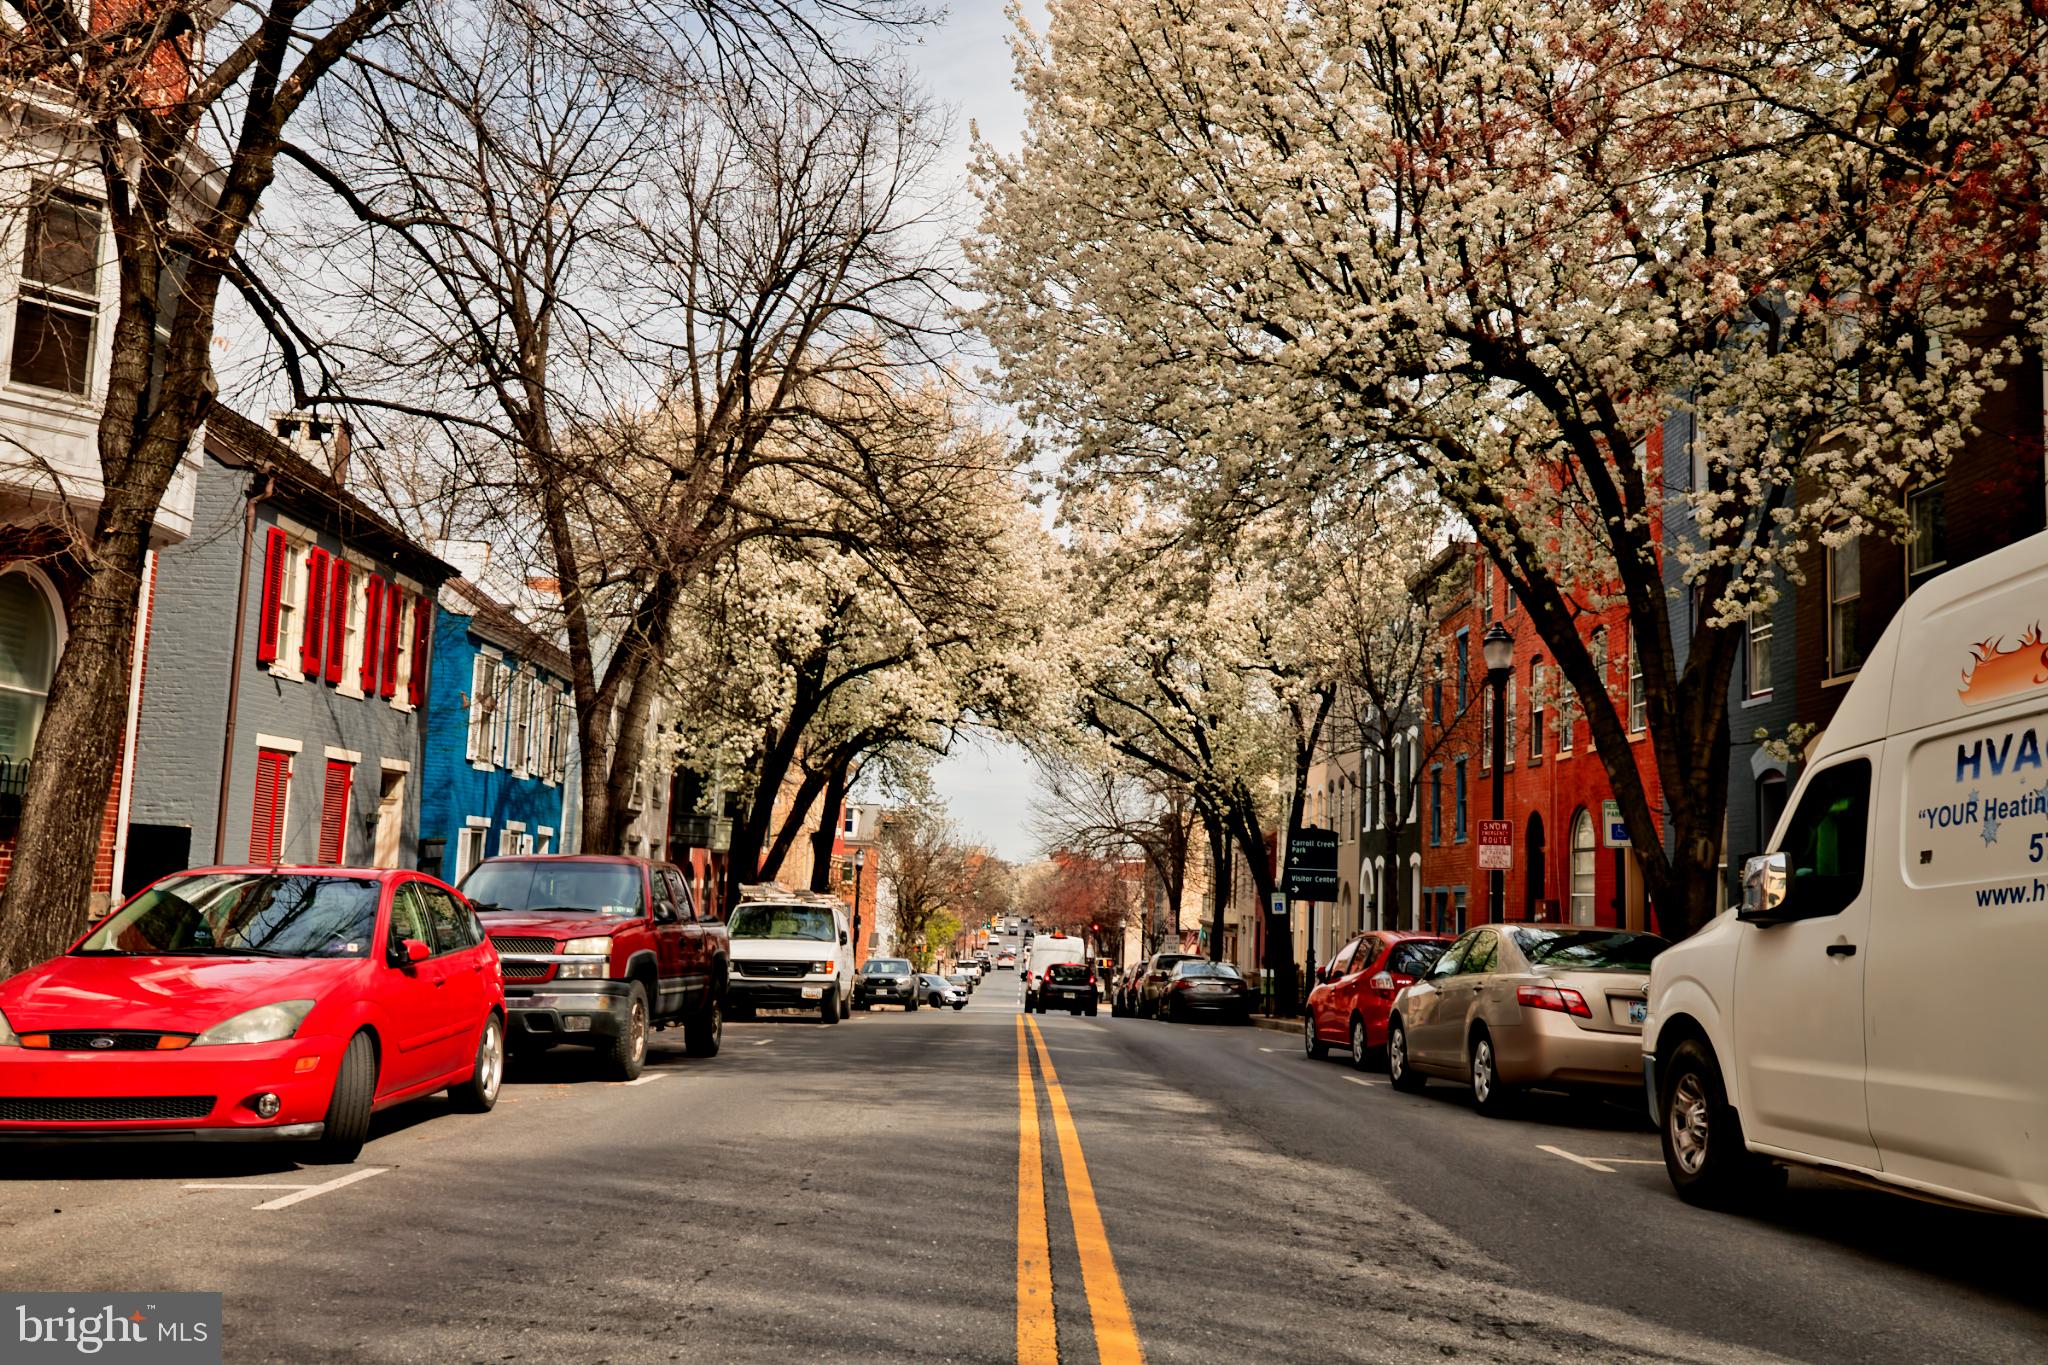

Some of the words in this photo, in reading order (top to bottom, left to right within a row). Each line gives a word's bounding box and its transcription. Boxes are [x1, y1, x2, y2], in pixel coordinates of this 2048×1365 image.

[1955, 728, 2048, 783] HVA
[1984, 792, 2048, 821] Heatin
[1482, 836, 1508, 844] ROUTE
[1483, 822, 1508, 830] SNOW
[2029, 832, 2048, 863] 5
[1976, 878, 2048, 907] www.h
